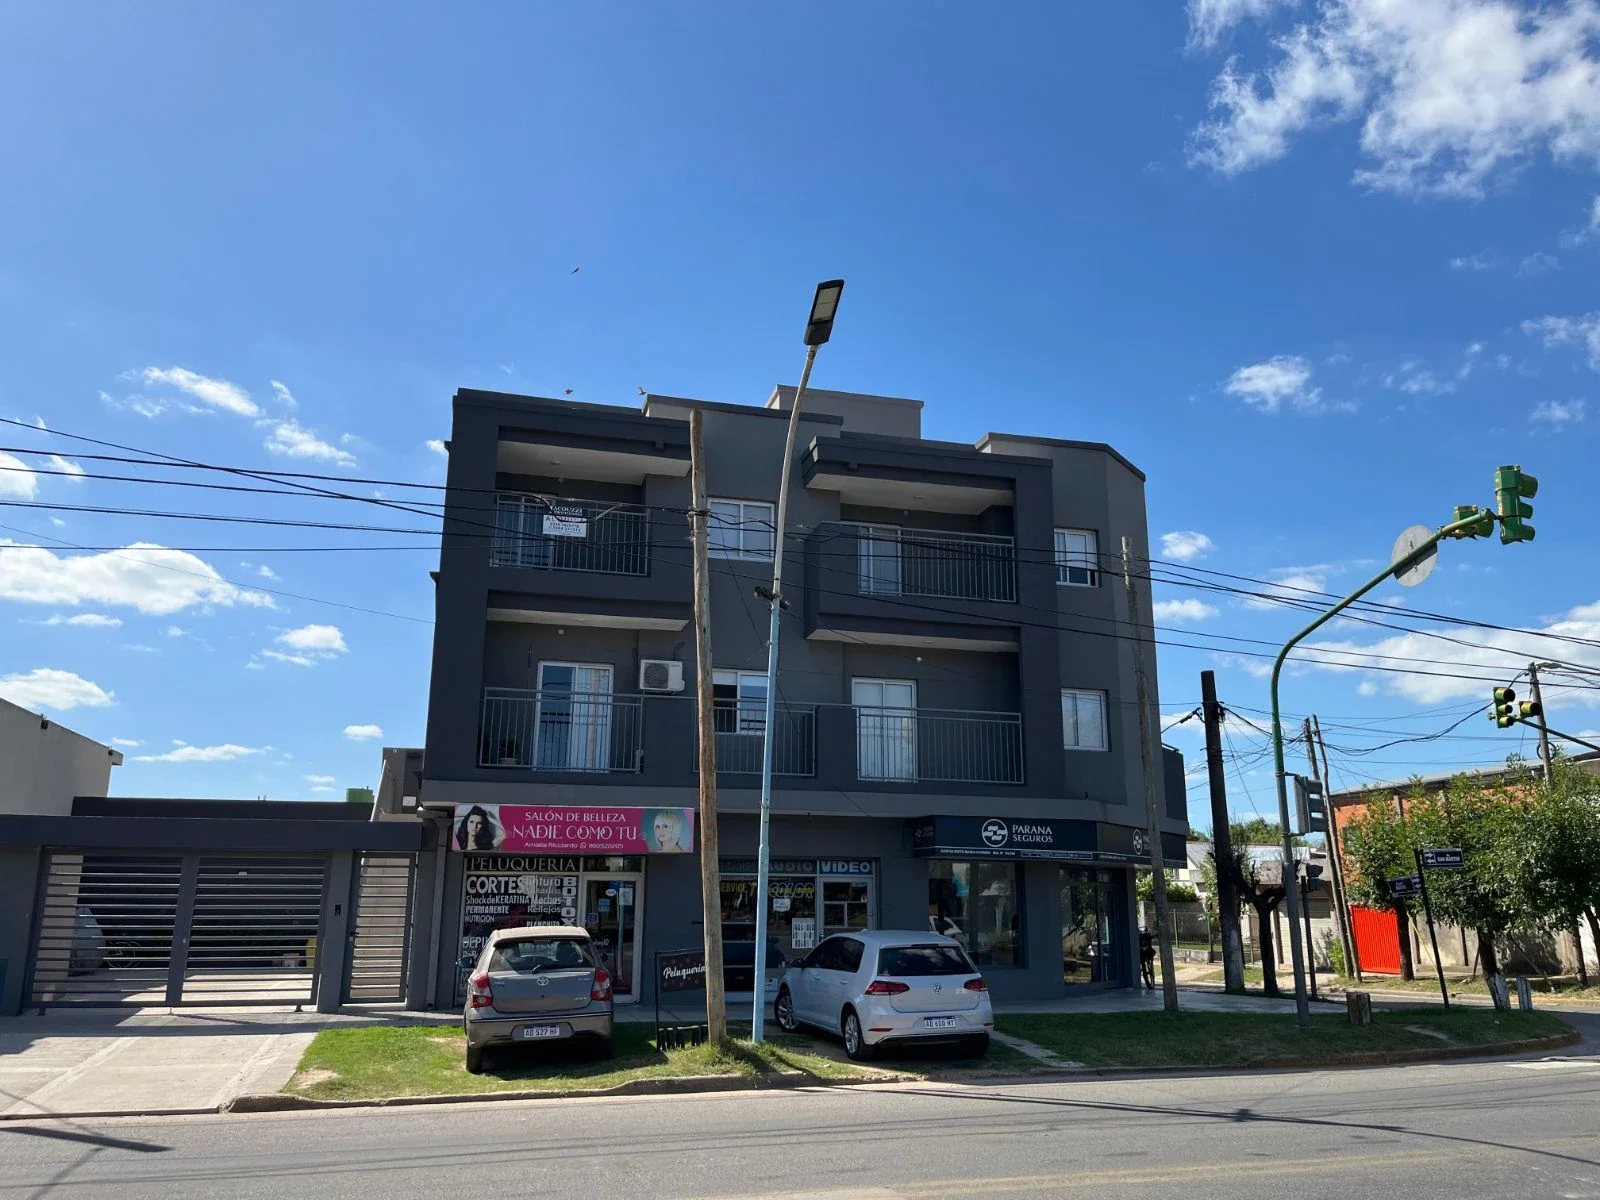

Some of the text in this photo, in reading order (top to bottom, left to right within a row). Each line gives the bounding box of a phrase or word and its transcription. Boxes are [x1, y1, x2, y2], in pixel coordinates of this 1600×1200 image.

[525, 810, 626, 822] SALÓN DE BELLEZA
[512, 824, 637, 840] NADIE COMO TU
[1012, 824, 1052, 835] PARANA
[1012, 834, 1053, 843] SEGUROS
[769, 860, 813, 872] AUDIO
[821, 860, 870, 872] VIDEO
[466, 876, 524, 894] CORTES
[466, 905, 509, 914] PERMANENTE
[528, 905, 560, 914] Reflejos
